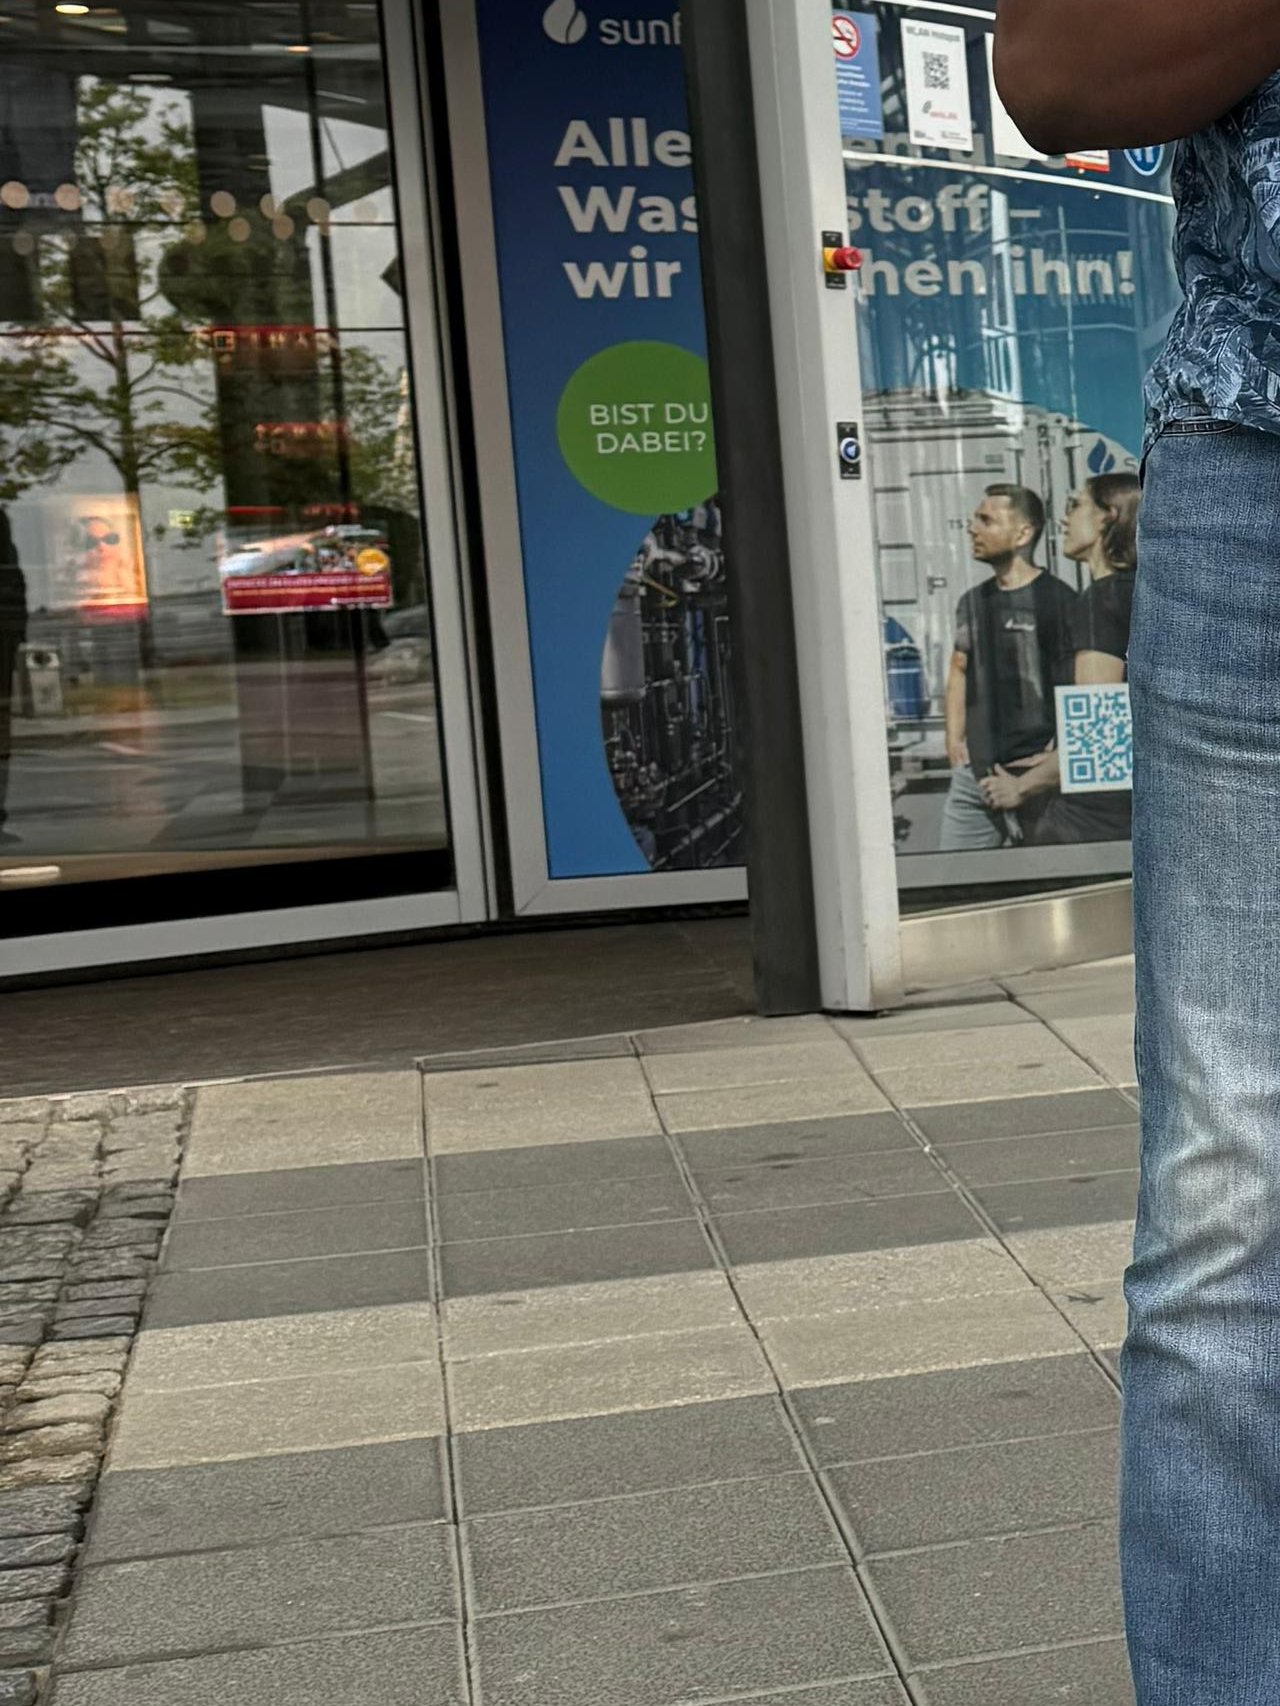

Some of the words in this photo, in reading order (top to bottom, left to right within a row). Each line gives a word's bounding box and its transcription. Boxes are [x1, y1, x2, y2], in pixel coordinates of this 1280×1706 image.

[553, 117, 693, 168] Alle
[562, 245, 683, 299] wir
[1010, 245, 1136, 296] ihn!
[590, 403, 655, 425] BIST
[664, 402, 709, 424] DU
[596, 431, 706, 454] DABEI?
